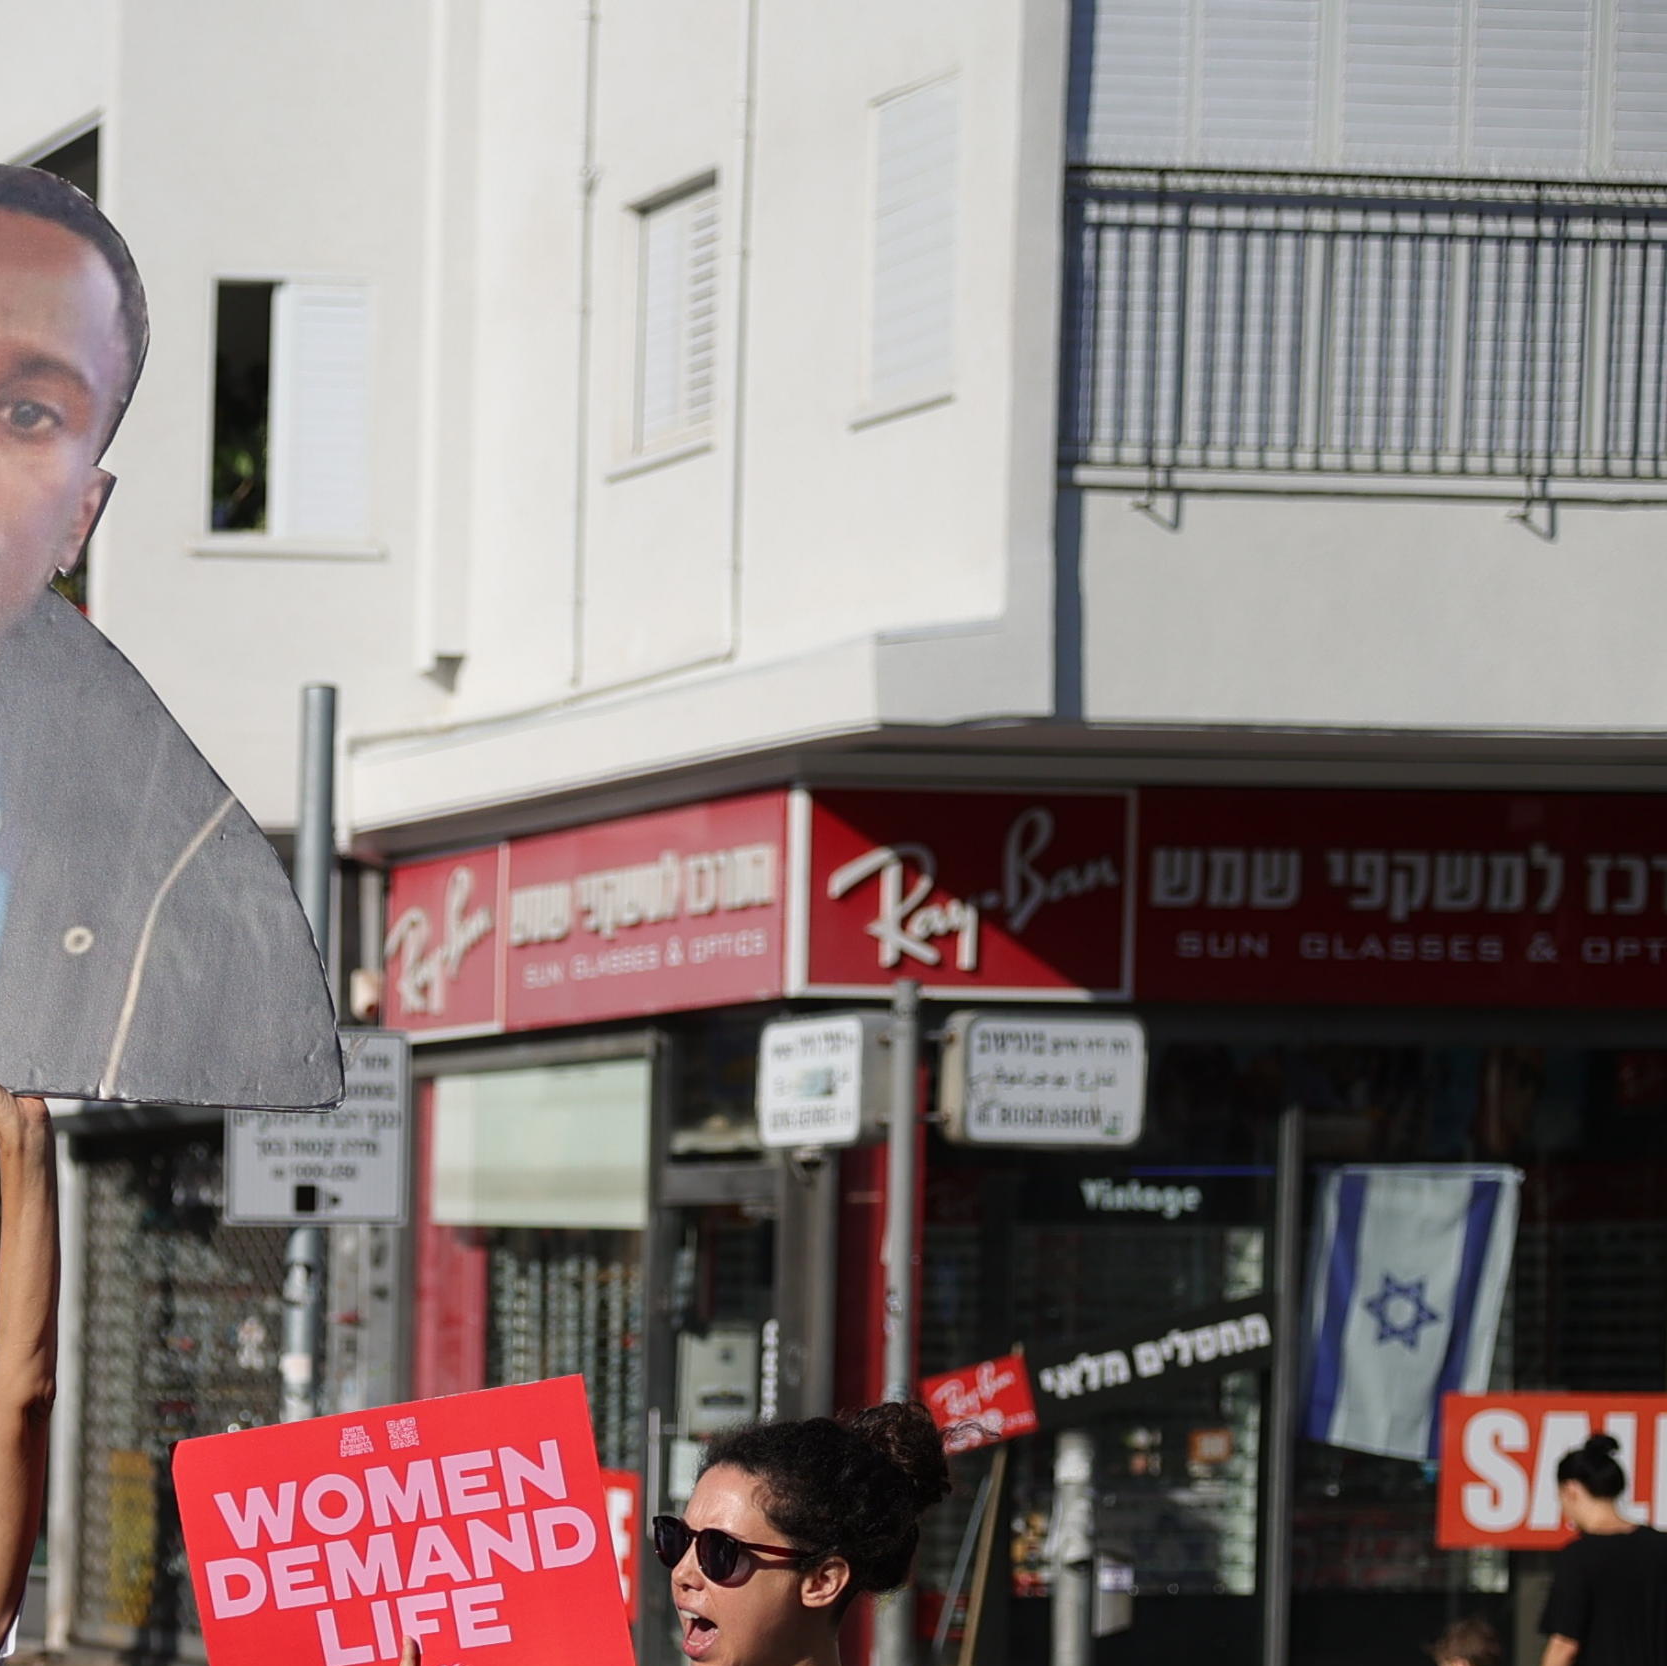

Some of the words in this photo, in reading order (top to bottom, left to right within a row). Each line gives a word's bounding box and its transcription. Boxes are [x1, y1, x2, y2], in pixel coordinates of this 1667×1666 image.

[1149, 848, 1302, 909] שמש
[1326, 843, 1565, 922] למשקפי
[523, 962, 563, 988] SUN
[571, 944, 660, 979] GLASSES
[665, 937, 684, 966] &
[689, 929, 767, 962] OPTICS
[1176, 932, 1270, 958] SUN
[1300, 933, 1504, 961] GLASSES
[1527, 935, 1558, 963] &
[1079, 1177, 1204, 1219] Vintage
[213, 1439, 568, 1550] WOMEN
[1462, 1407, 1667, 1534] SAL
[204, 1505, 597, 1620] DEMAND
